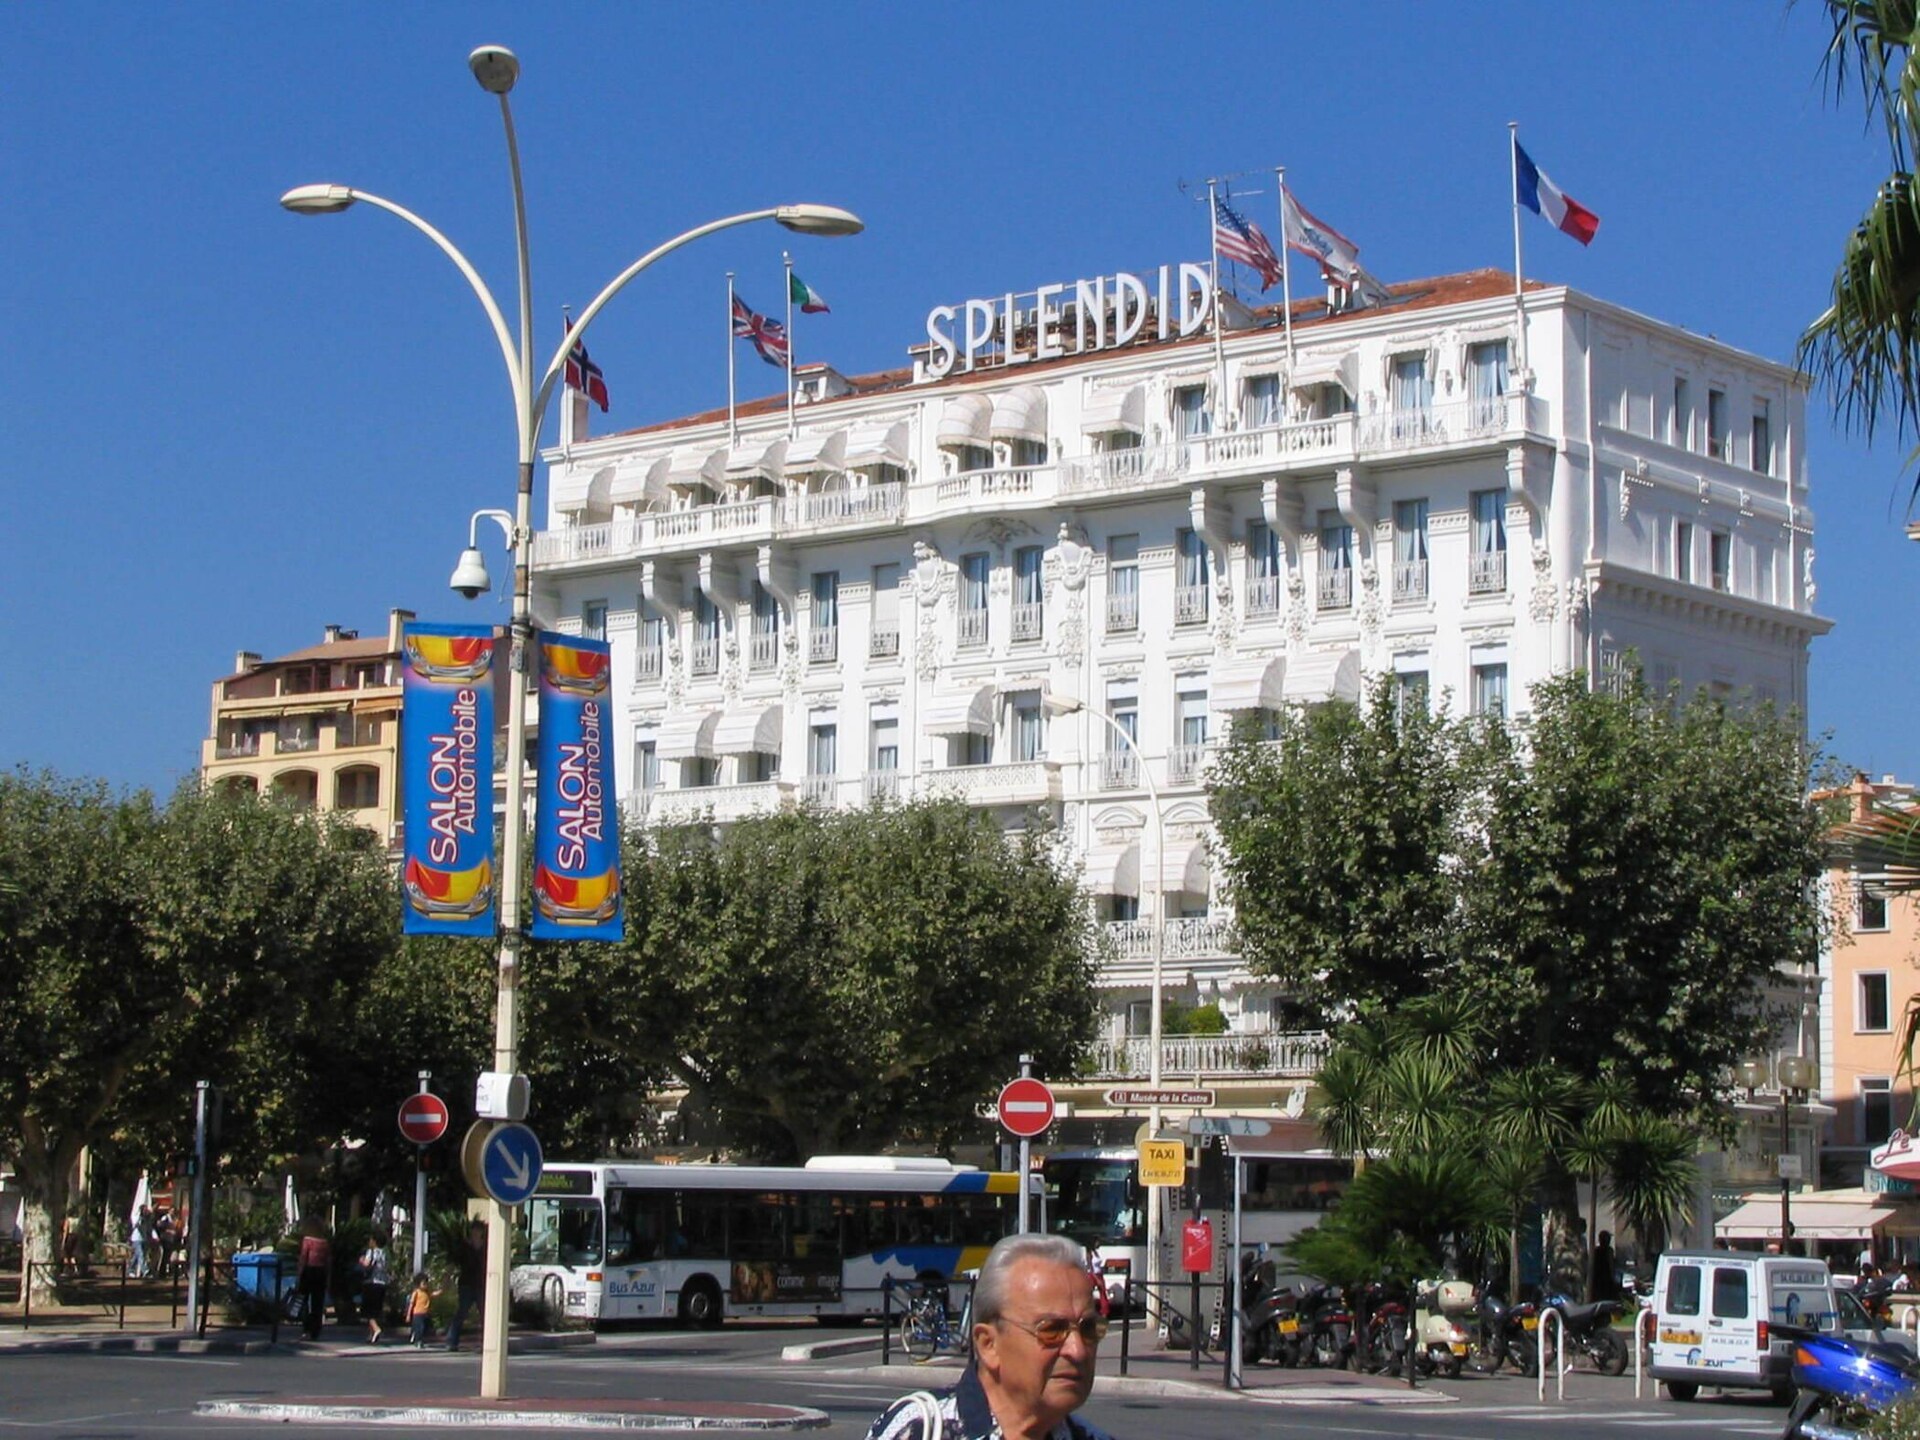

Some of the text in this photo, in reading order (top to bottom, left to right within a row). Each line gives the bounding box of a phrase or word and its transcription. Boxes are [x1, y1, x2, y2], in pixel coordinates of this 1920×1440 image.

[926, 262, 1212, 378] SPLENDID
[431, 736, 457, 864] SALON
[453, 689, 476, 834] Automobile
[558, 745, 586, 870] SALON
[581, 701, 603, 841] Automobile
[1130, 1092, 1158, 1103] Musée
[1160, 1093, 1170, 1103] de
[1172, 1093, 1180, 1103] la
[1149, 1149, 1175, 1159] TAXI
[609, 1281, 656, 1293] Bus Azur
